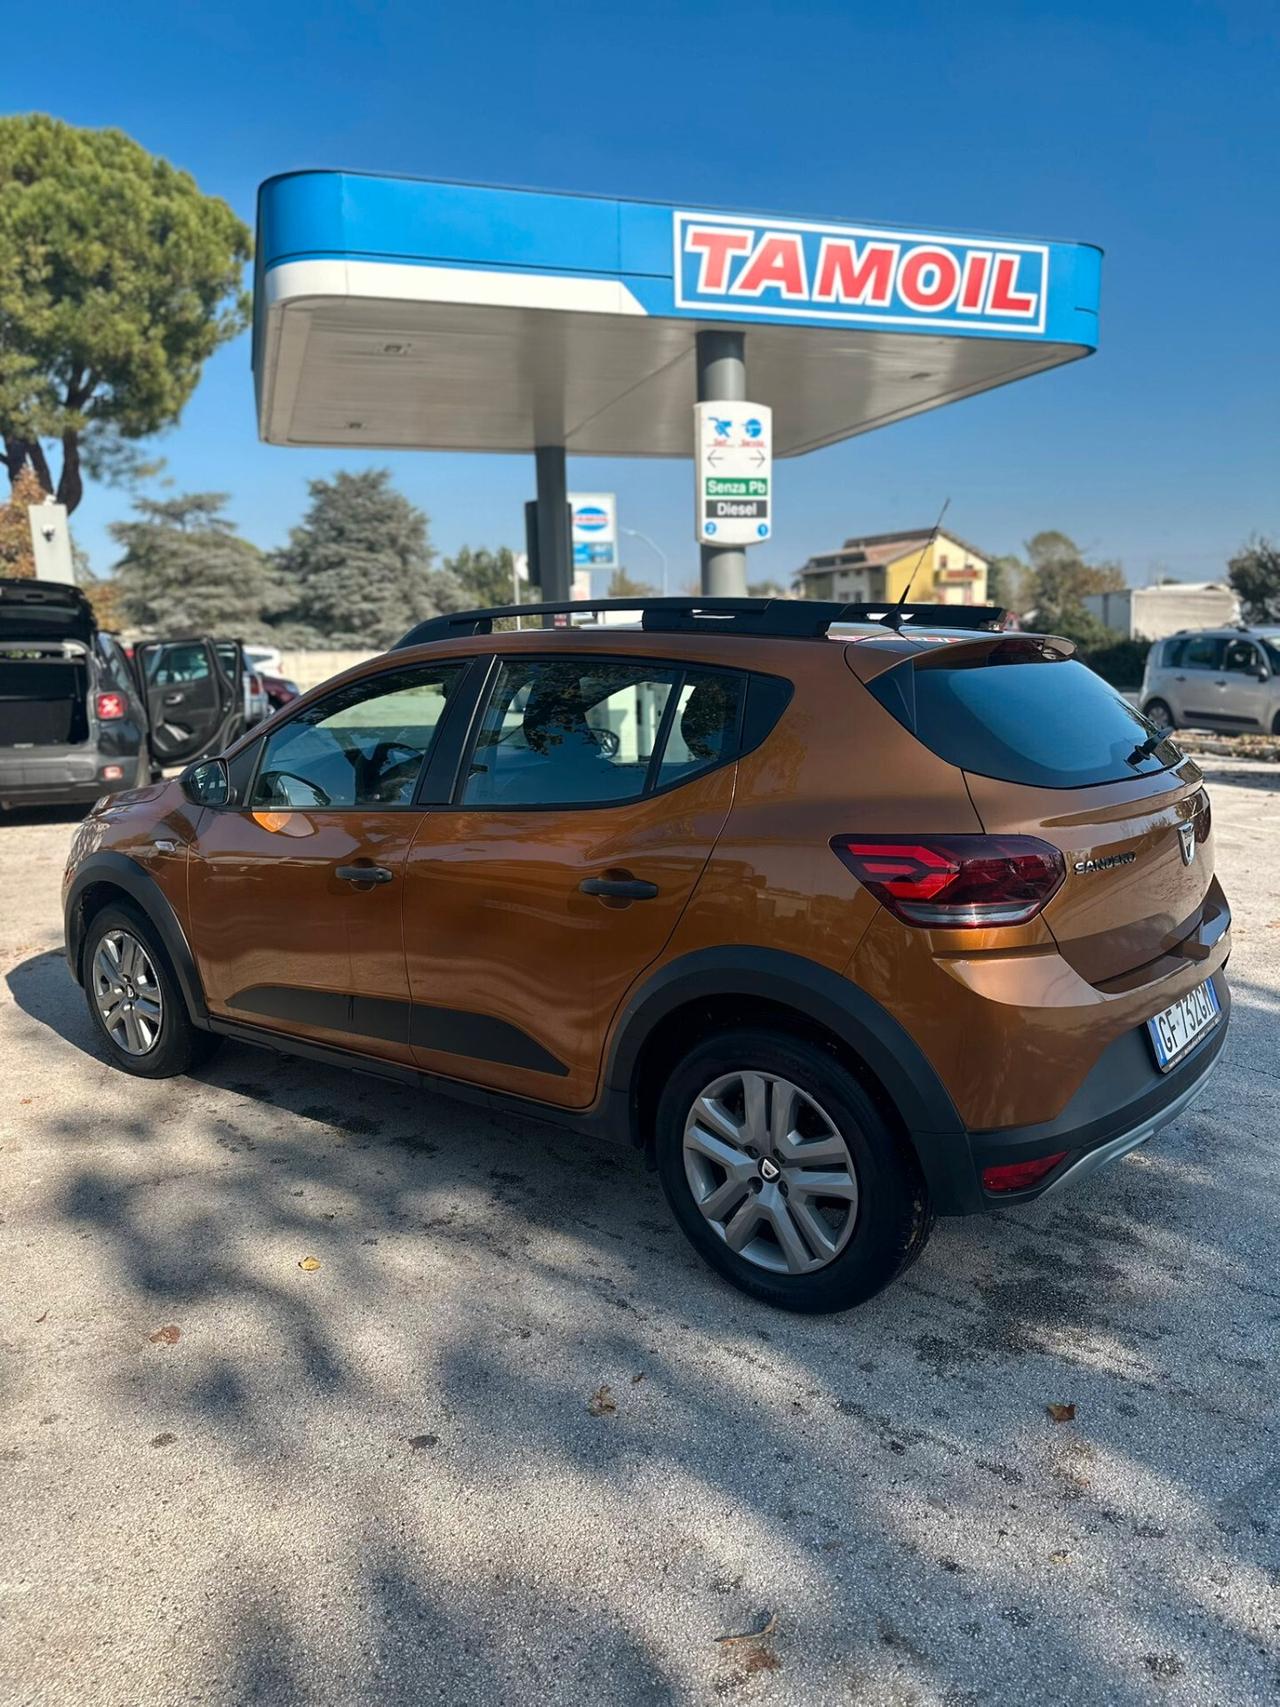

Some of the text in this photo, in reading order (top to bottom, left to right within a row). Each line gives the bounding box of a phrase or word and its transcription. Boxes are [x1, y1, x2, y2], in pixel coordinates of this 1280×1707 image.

[686, 225, 1038, 318] TAMOIL
[707, 480, 767, 494] Senza Pb
[717, 501, 757, 516] Diesel
[1073, 851, 1137, 875] SANDERO
